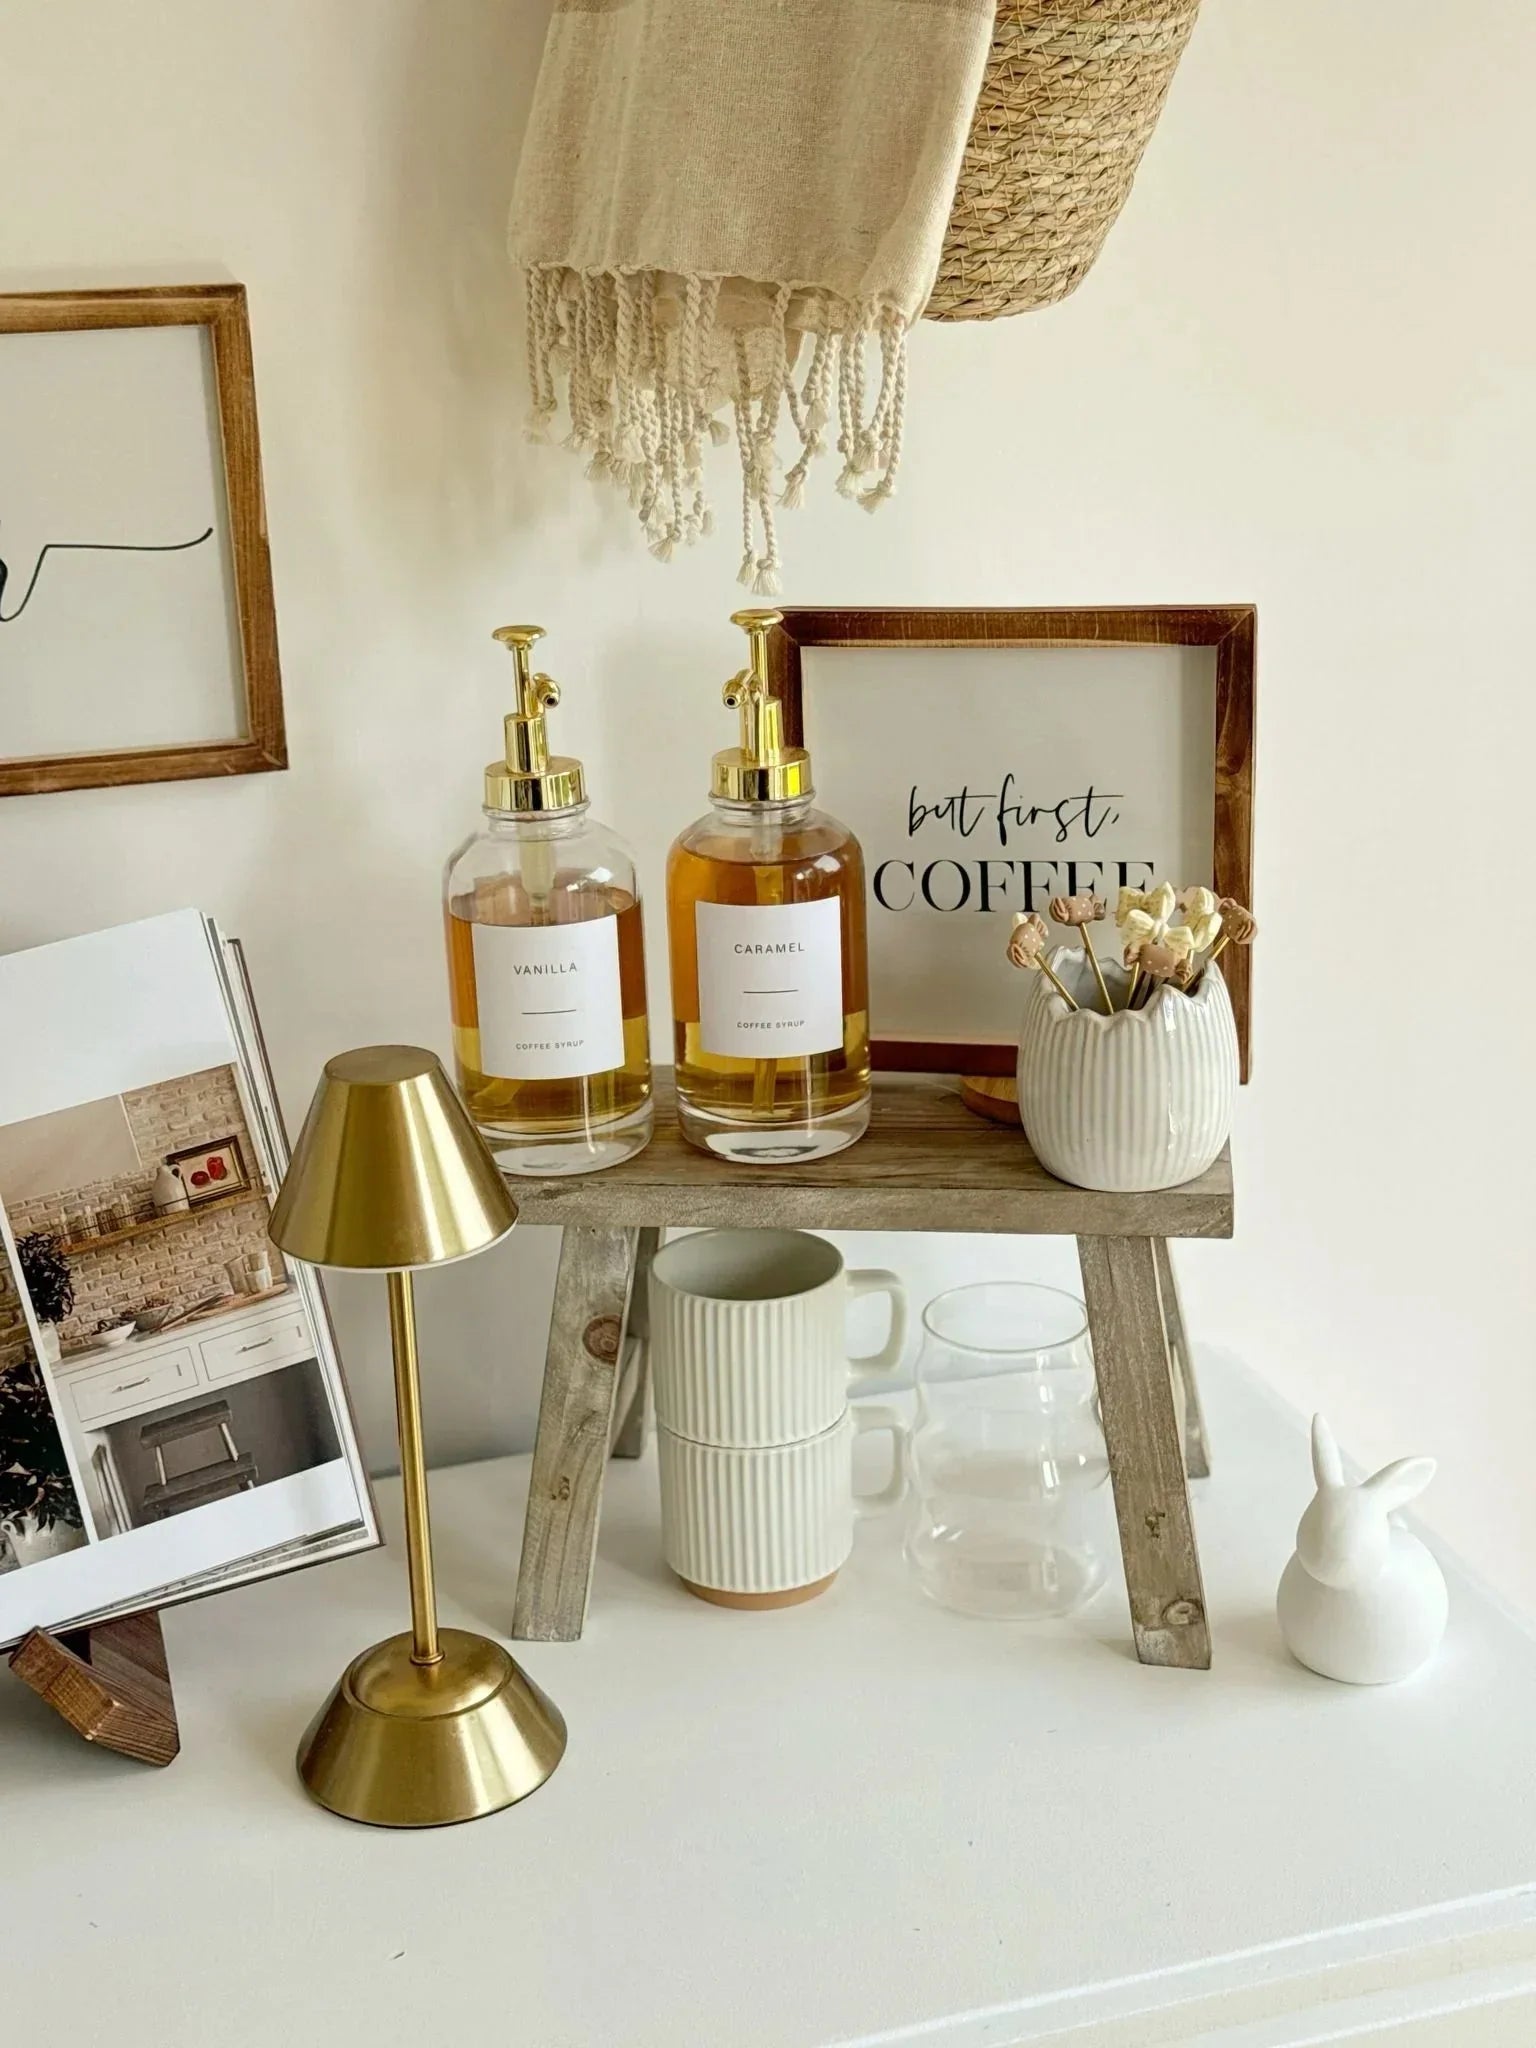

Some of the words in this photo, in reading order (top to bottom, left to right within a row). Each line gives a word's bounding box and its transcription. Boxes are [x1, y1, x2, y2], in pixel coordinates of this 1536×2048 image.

[908, 785, 997, 837] but
[997, 773, 1125, 846] first,
[734, 942, 805, 954] CARAMEL
[513, 962, 577, 975] VANILLA
[736, 1021, 772, 1029] COFFEE
[775, 1020, 805, 1028] SYRUP
[515, 1042, 551, 1050] COFFEE
[554, 1039, 584, 1049] SYRUP
